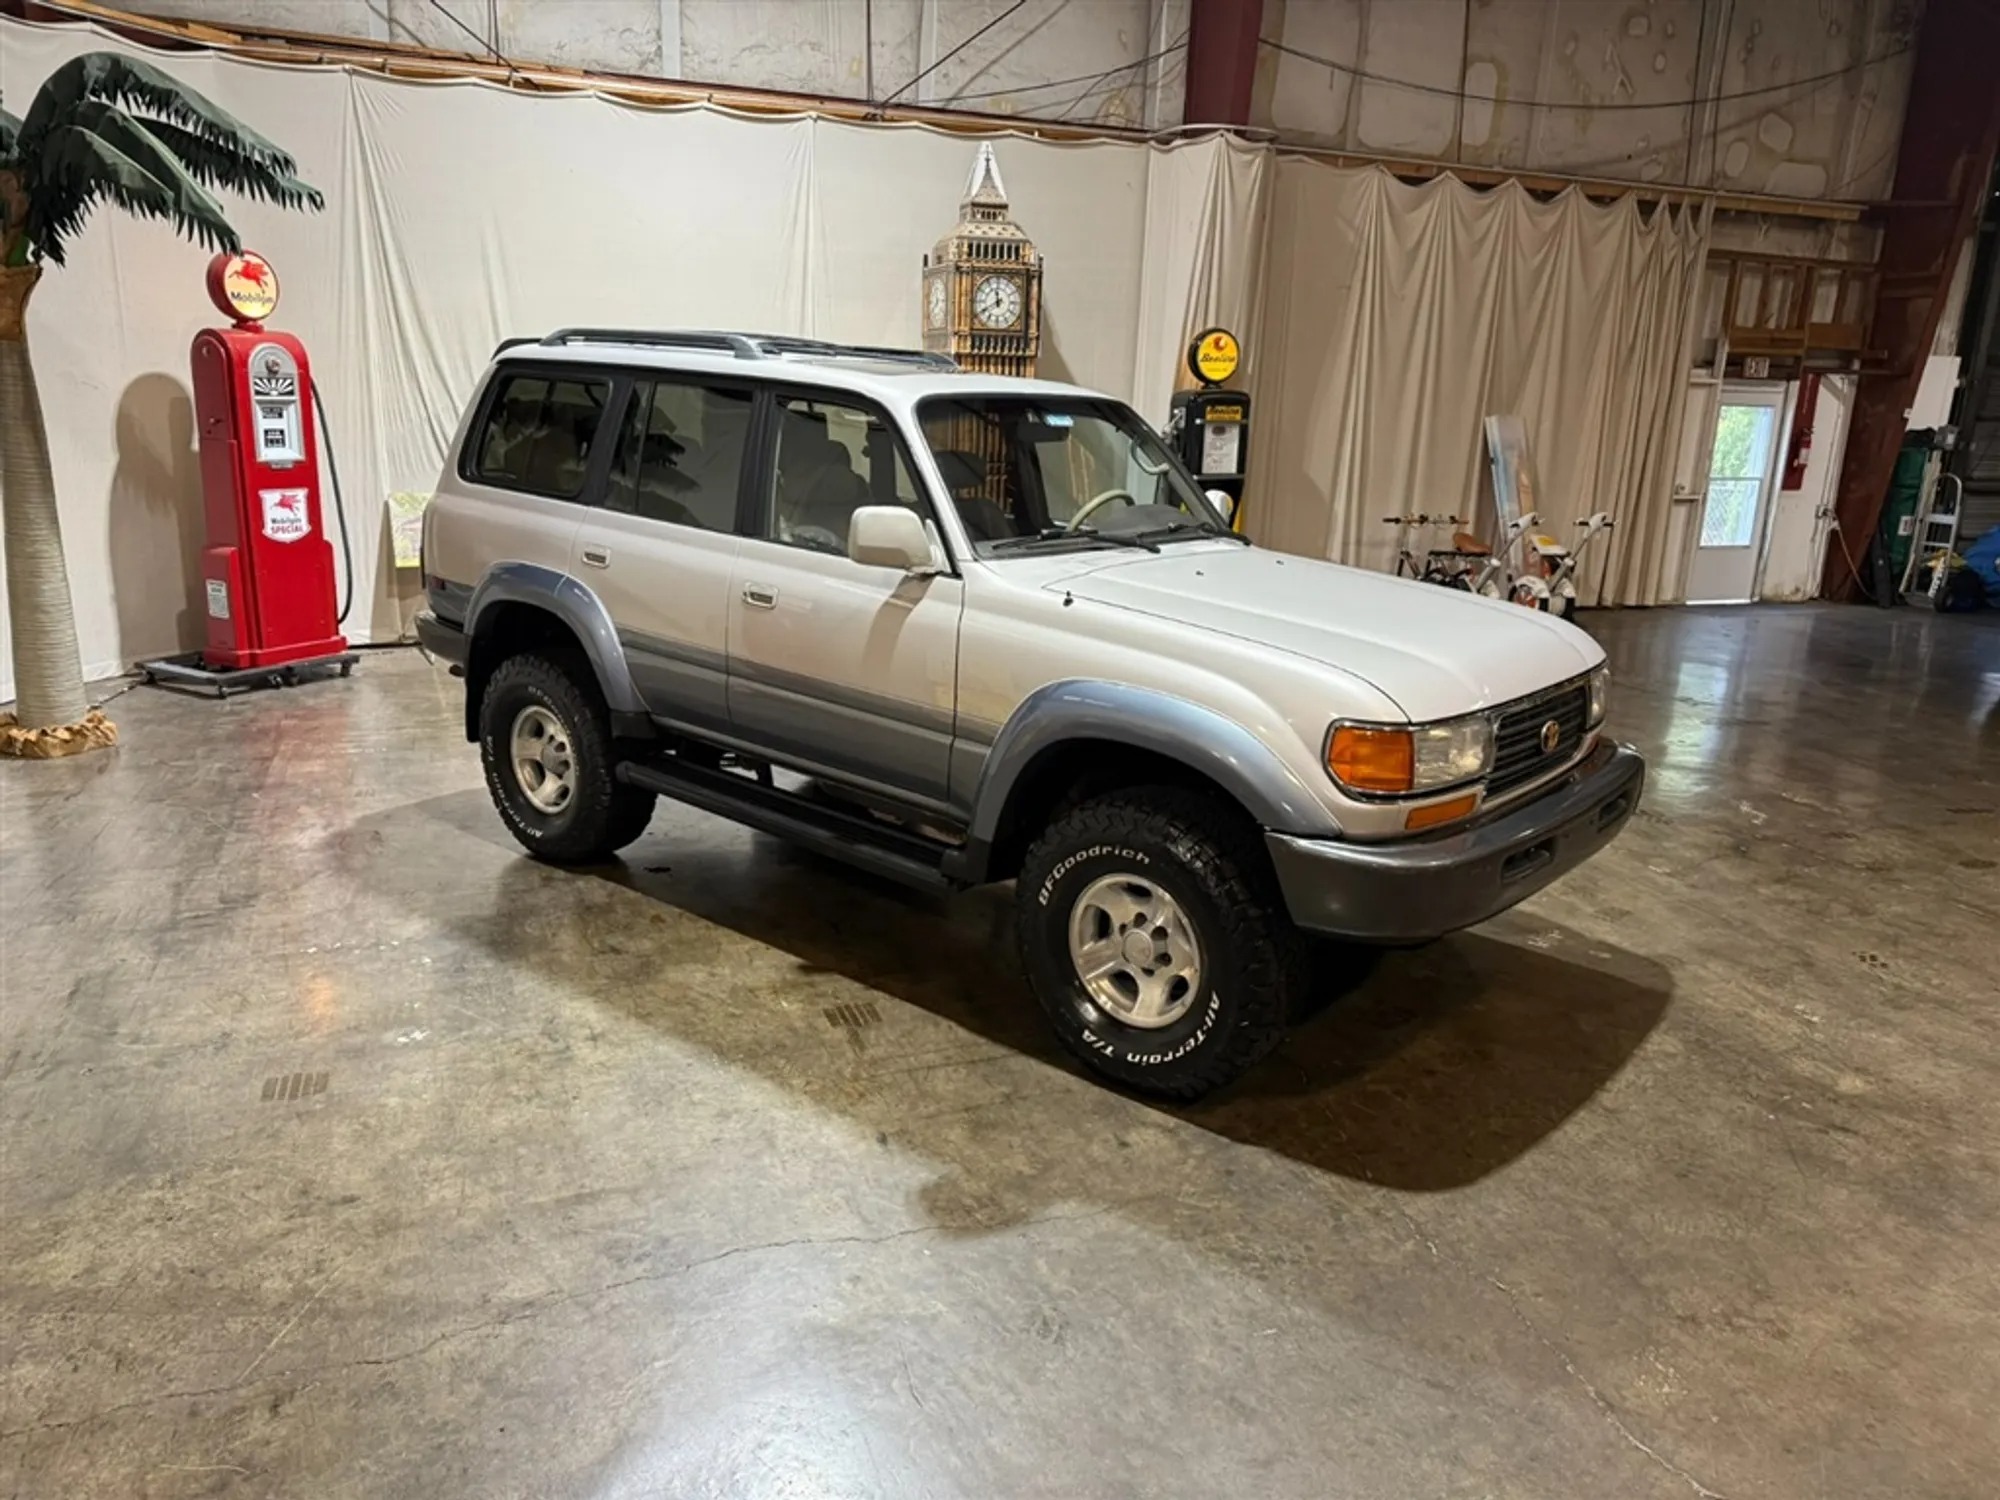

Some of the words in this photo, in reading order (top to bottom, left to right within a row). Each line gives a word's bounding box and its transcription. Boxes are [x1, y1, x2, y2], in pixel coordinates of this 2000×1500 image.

[1038, 845, 1150, 907] BFGoodrich
[1082, 1029, 1115, 1058] T/A
[1126, 990, 1220, 1067] All-Terrain
